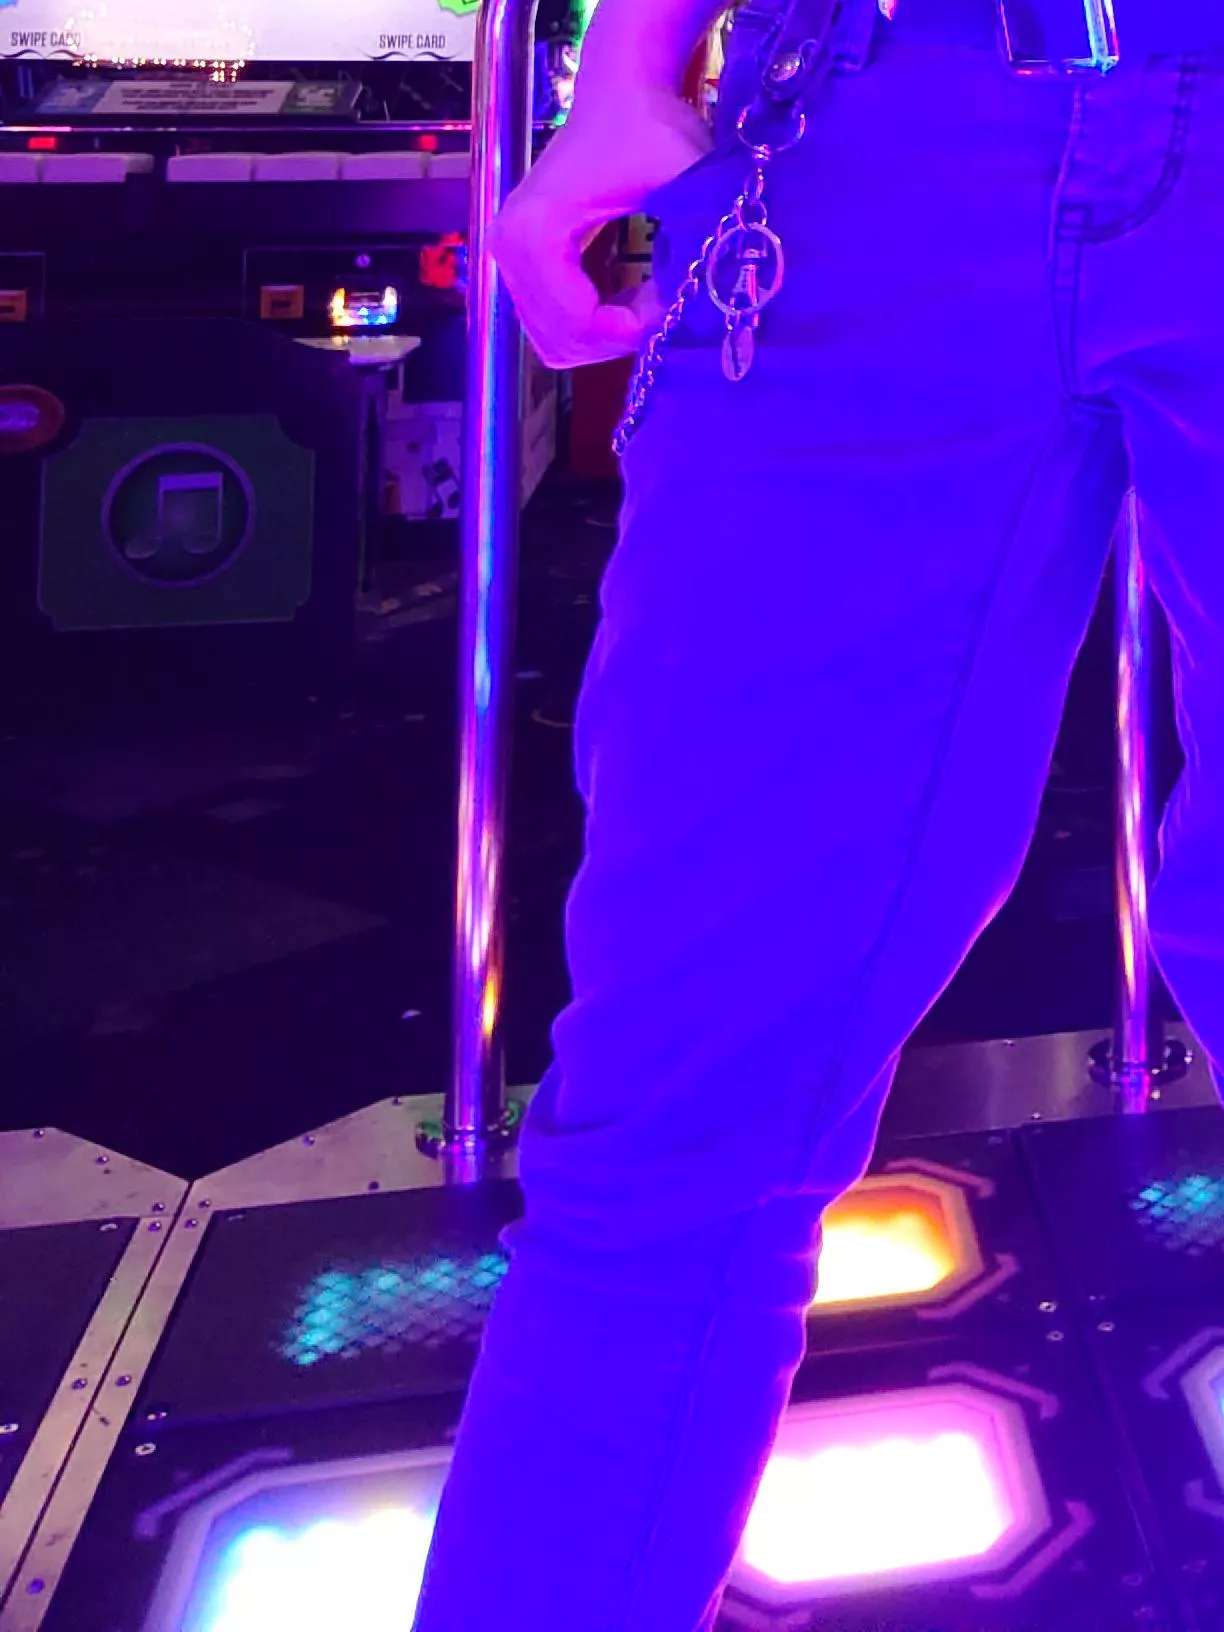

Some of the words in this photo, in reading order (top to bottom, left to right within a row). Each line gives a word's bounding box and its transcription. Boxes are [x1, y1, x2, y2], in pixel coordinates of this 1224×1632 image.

[11, 31, 47, 47] SWIPE
[379, 34, 413, 50] SWIPE
[416, 34, 446, 50] CARD
